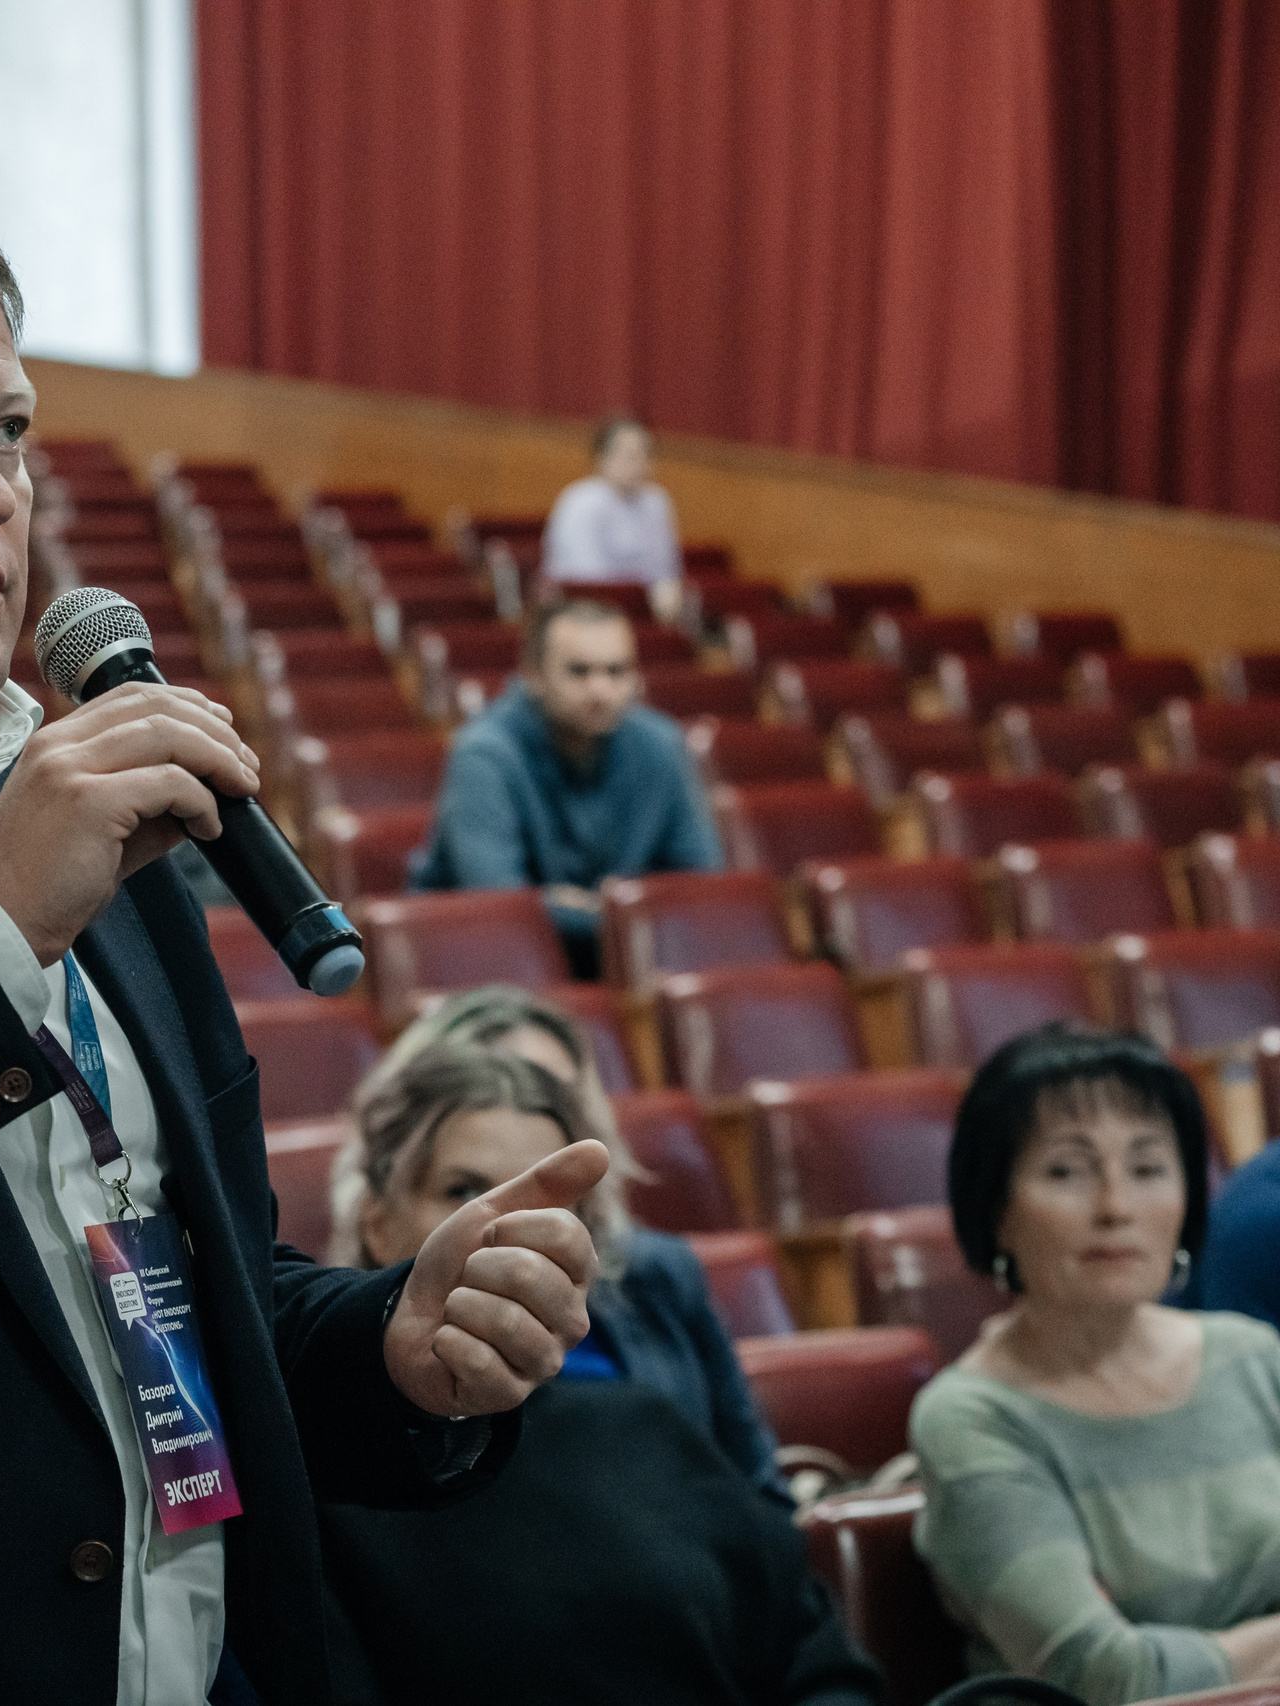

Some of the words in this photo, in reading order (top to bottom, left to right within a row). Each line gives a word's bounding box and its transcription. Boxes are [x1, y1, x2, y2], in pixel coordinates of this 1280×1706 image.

[145, 1264, 170, 1278] Сибирский
[116, 1288, 137, 1298] ENDOSCOPY
[119, 1299, 139, 1310] QUESTIONS
[147, 1296, 164, 1306] Форум
[163, 1304, 192, 1318] ENDOSCOPY
[138, 1383, 176, 1402] Базаров
[145, 1404, 184, 1431] Дмитрий
[151, 1429, 214, 1454] Владимирович
[164, 1469, 223, 1507] ЭКСПЕРТ
